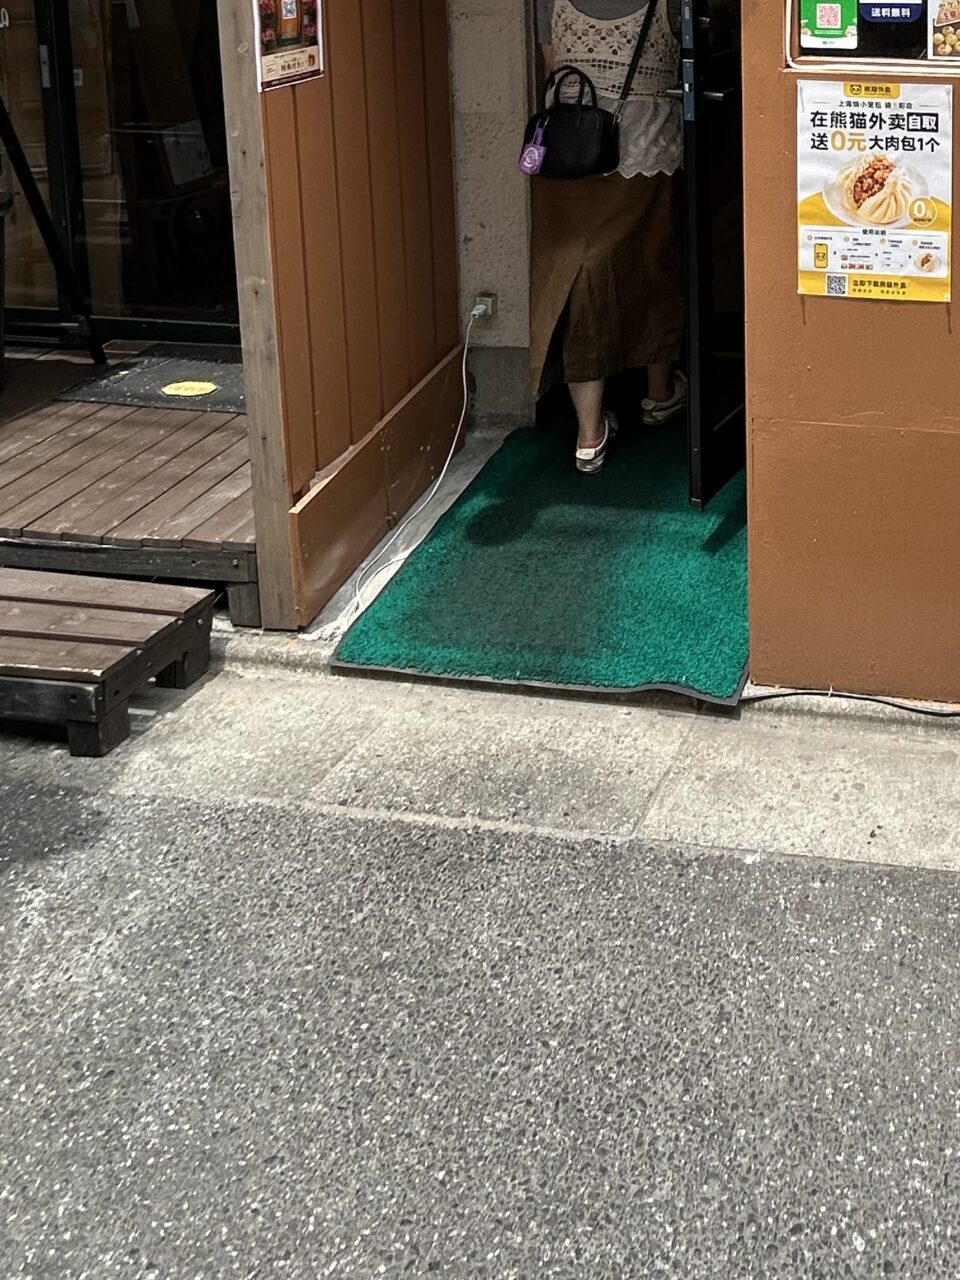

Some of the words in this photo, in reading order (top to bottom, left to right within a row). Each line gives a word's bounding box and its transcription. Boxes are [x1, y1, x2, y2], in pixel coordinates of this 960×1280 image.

[871, 8, 911, 18] 送料無料
[810, 110, 938, 132] 在熊猫外卖自取
